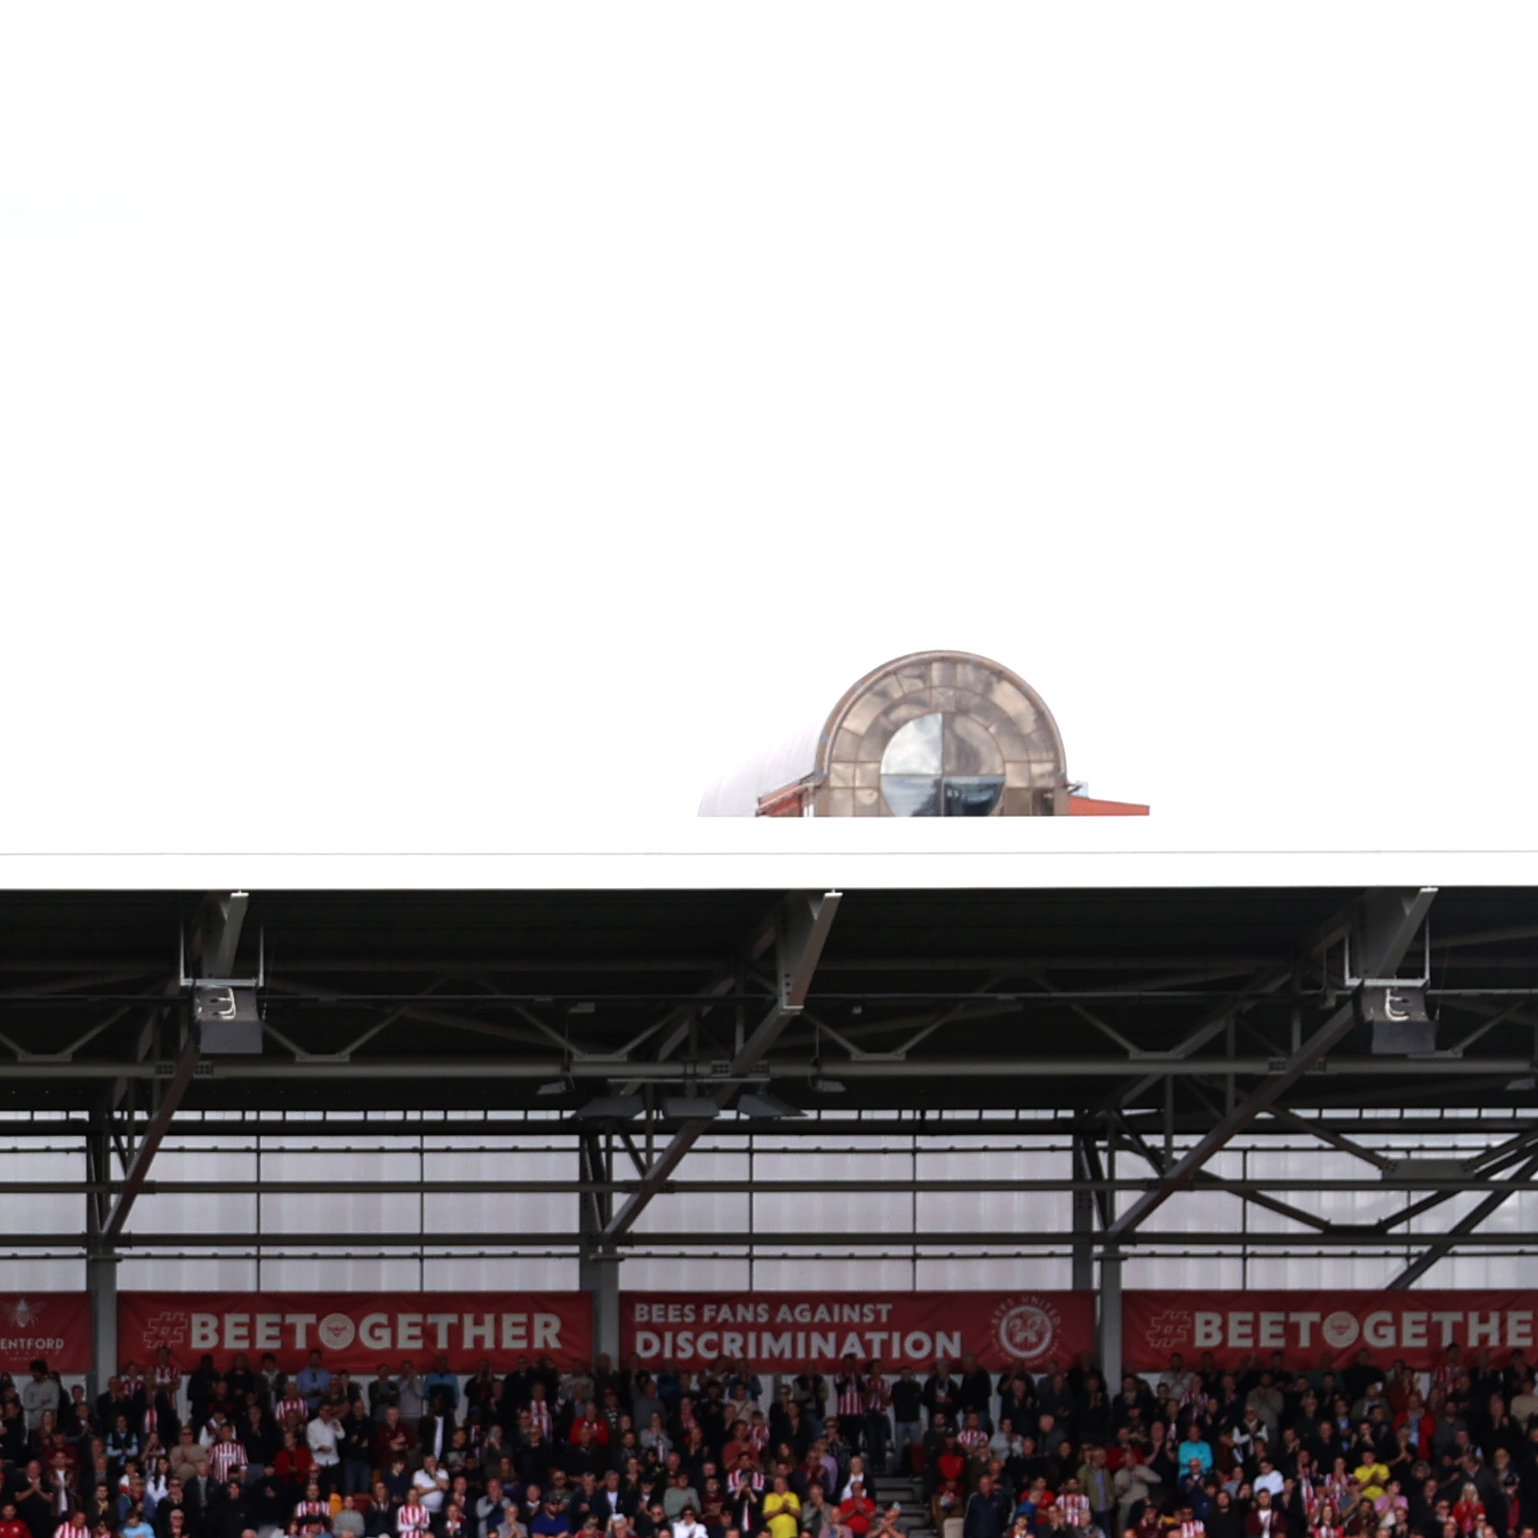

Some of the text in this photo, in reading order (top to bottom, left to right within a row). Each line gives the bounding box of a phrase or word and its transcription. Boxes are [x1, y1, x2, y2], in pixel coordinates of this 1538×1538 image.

[634, 1304, 893, 1323] BEES FANS AGAINST
[636, 1331, 962, 1359] DISCRIMINATION
